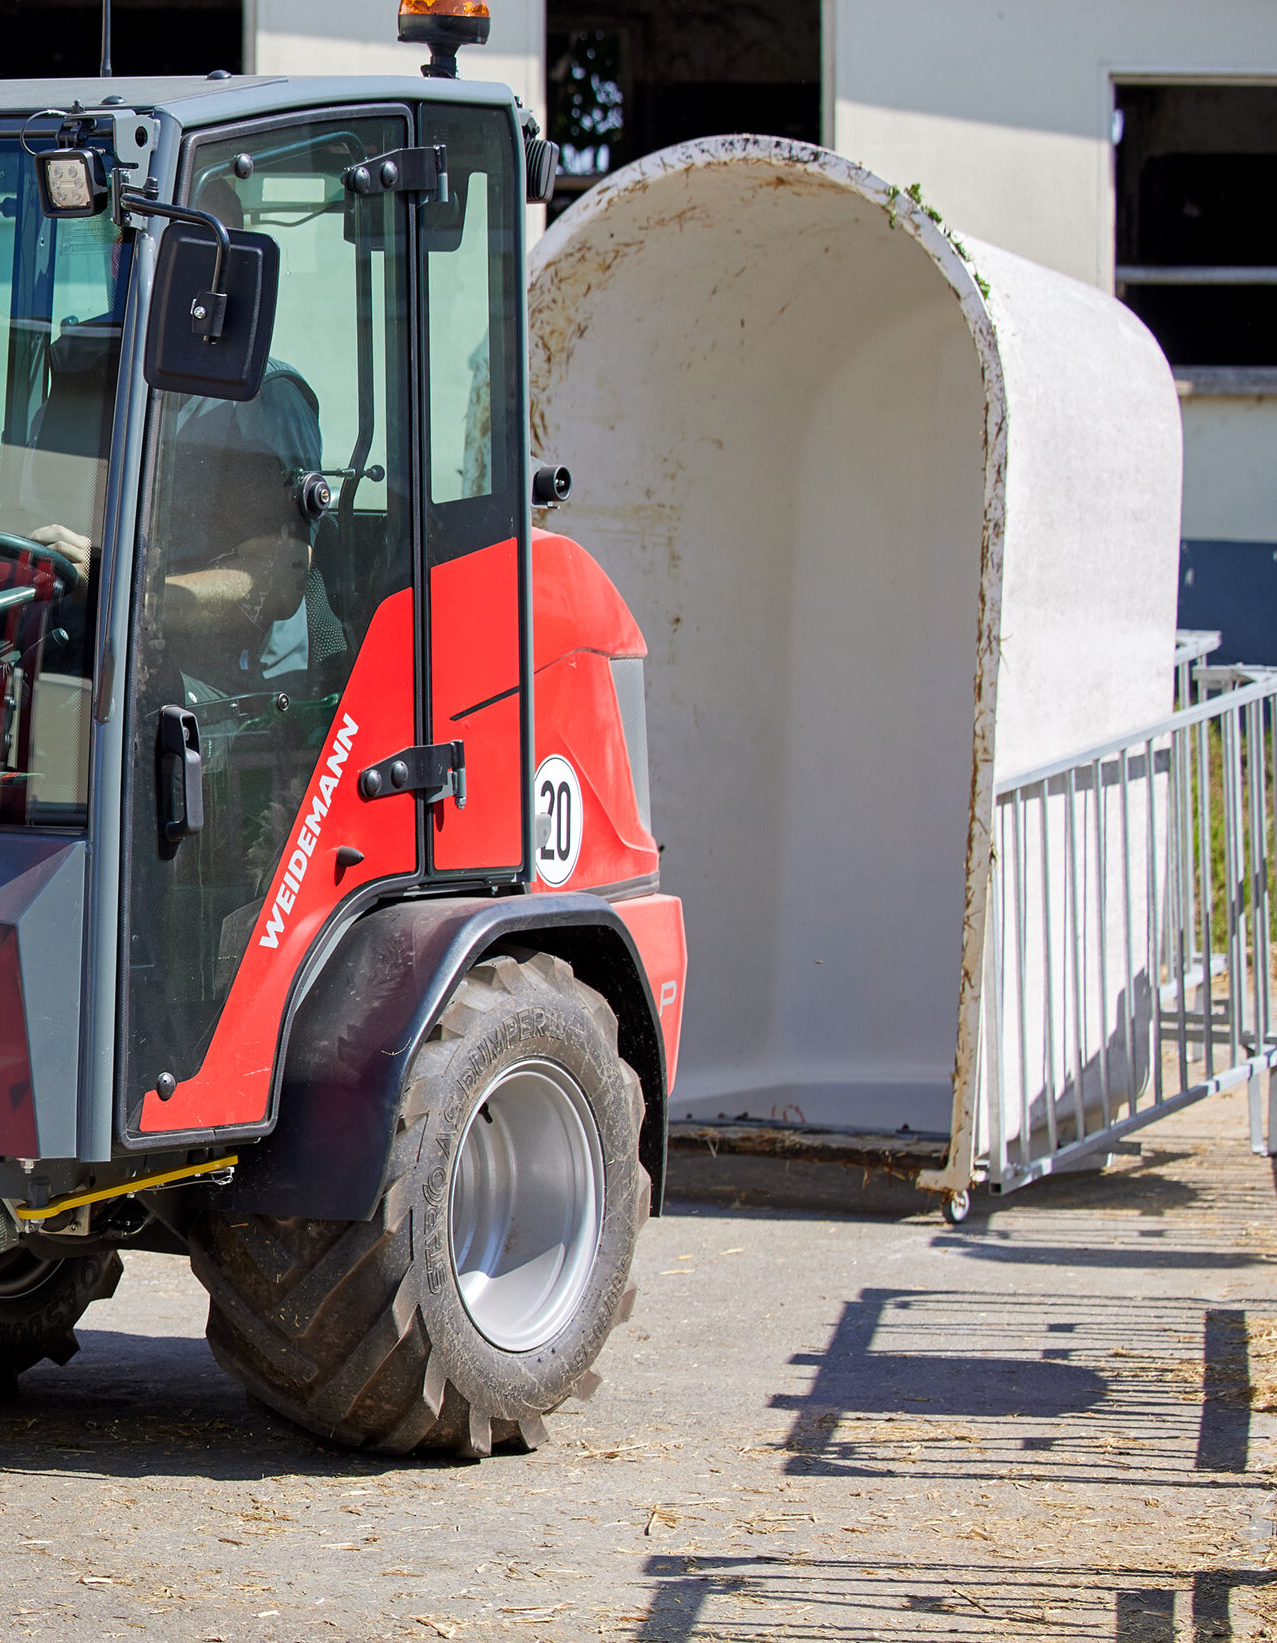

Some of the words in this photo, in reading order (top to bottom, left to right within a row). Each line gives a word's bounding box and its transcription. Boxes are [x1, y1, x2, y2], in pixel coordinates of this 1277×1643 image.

[259, 712, 359, 949] WEIDEMANN
[540, 780, 571, 861] 20
[455, 1006, 546, 1100] DUMPER
